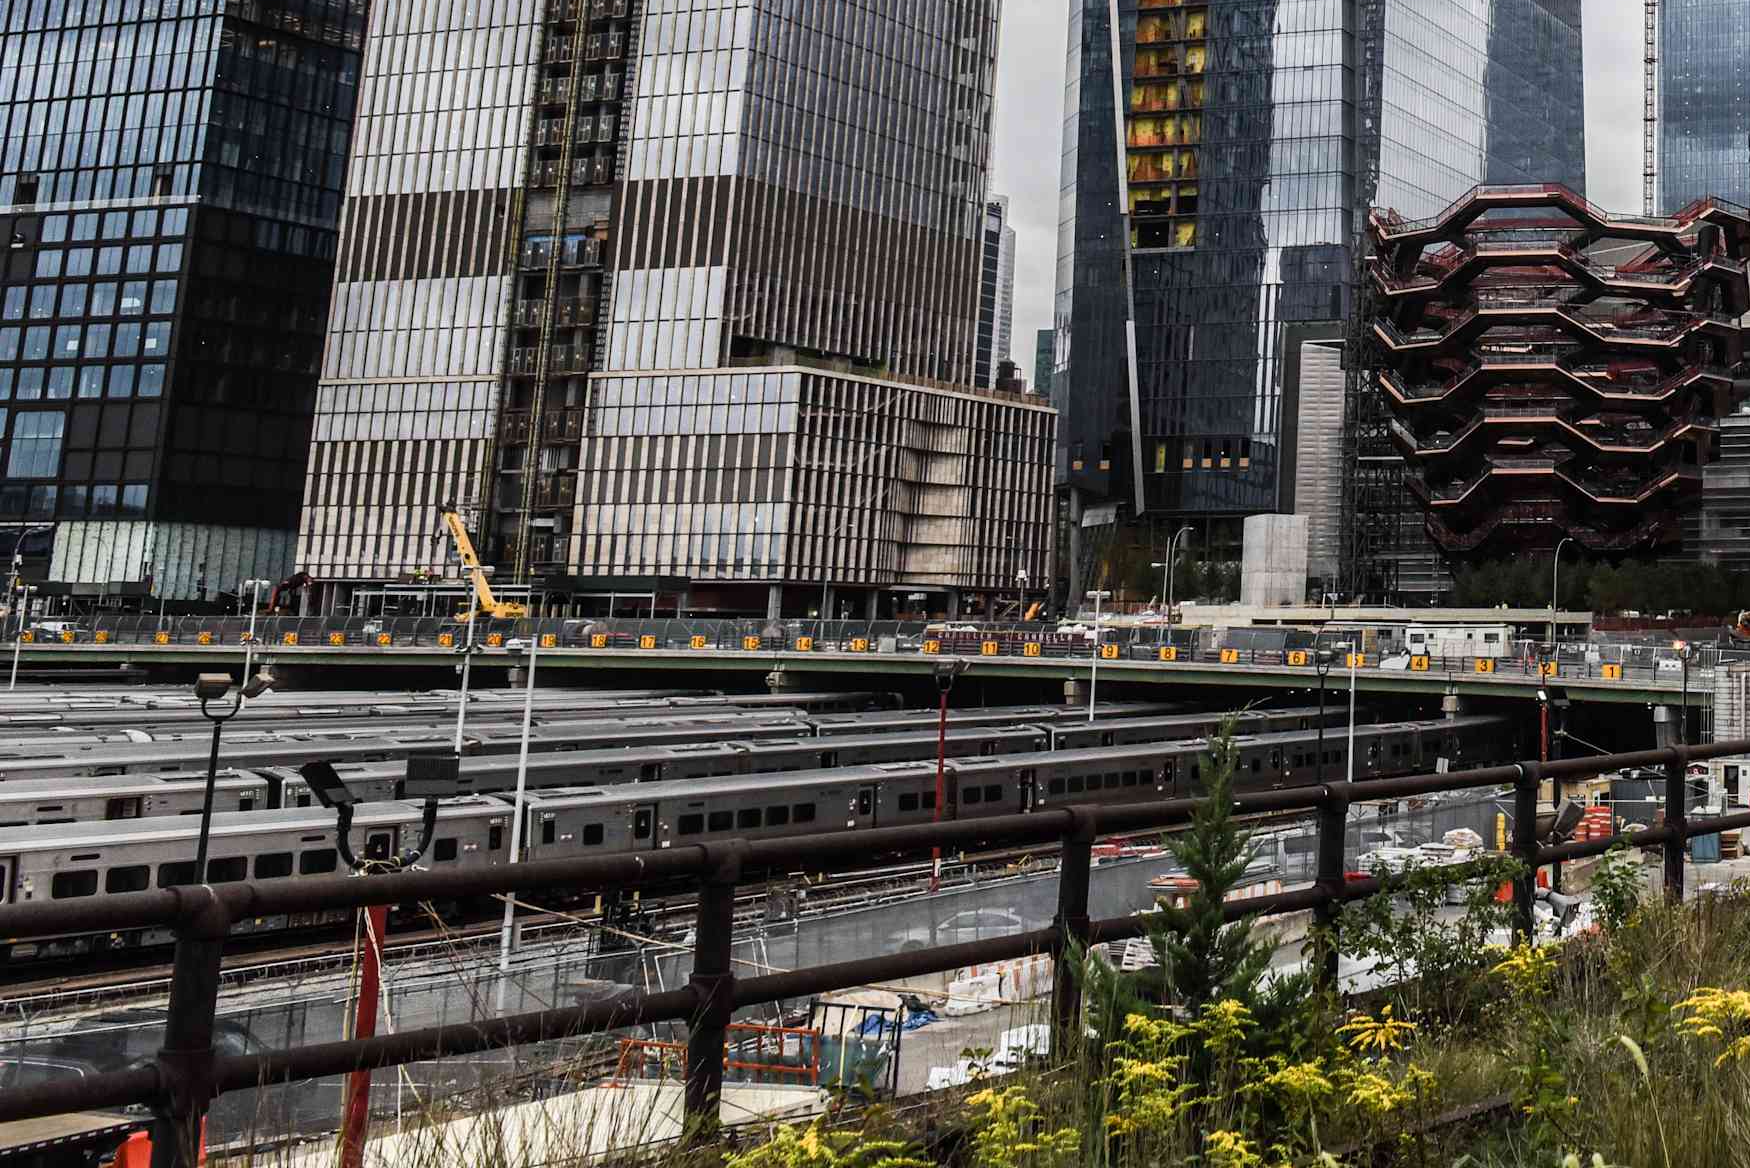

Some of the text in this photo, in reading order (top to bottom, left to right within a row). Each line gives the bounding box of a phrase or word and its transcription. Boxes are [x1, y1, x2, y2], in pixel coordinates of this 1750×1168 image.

[593, 635, 606, 647] 18
[642, 636, 655, 647] 17
[692, 637, 704, 648] 16
[744, 637, 756, 649] 15
[798, 638, 810, 649] 14
[854, 639, 866, 650] 13
[926, 641, 938, 652] 12
[984, 643, 996, 654] 11
[1026, 643, 1039, 655] 10
[1106, 645, 1114, 657] 9
[1164, 647, 1172, 659] 8
[1293, 652, 1300, 664] 6
[1416, 657, 1424, 668] 4
[1480, 660, 1488, 672] 3
